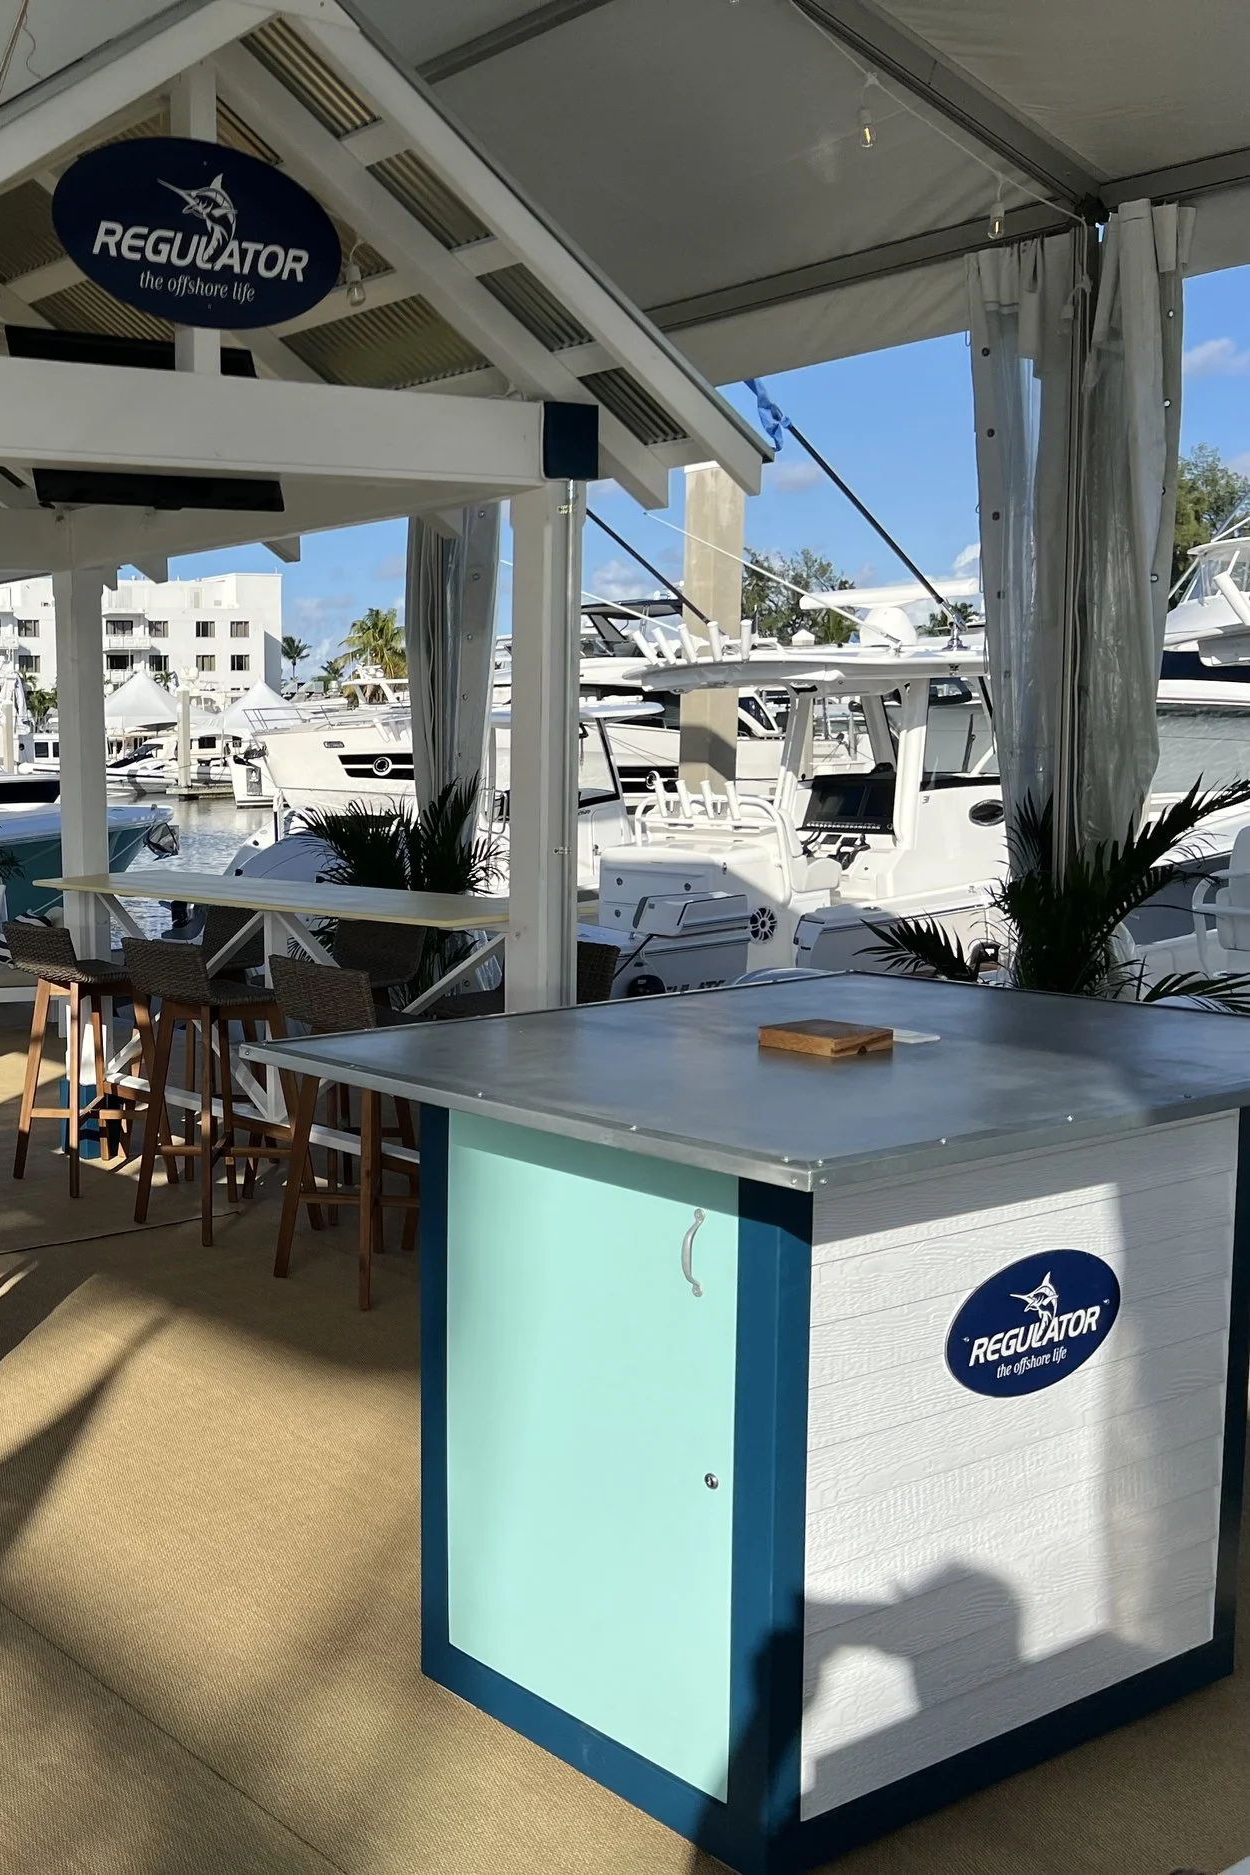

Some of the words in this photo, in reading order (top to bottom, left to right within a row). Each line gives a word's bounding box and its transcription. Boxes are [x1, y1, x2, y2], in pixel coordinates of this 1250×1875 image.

[92, 220, 310, 283] REGULATOR
[139, 270, 163, 290] the
[167, 273, 229, 300] offshore
[233, 283, 256, 305] life
[968, 1305, 1101, 1367] REGULATOR
[996, 1363, 1012, 1379] the
[1013, 1351, 1051, 1375] offshore
[1052, 1345, 1068, 1363] life
